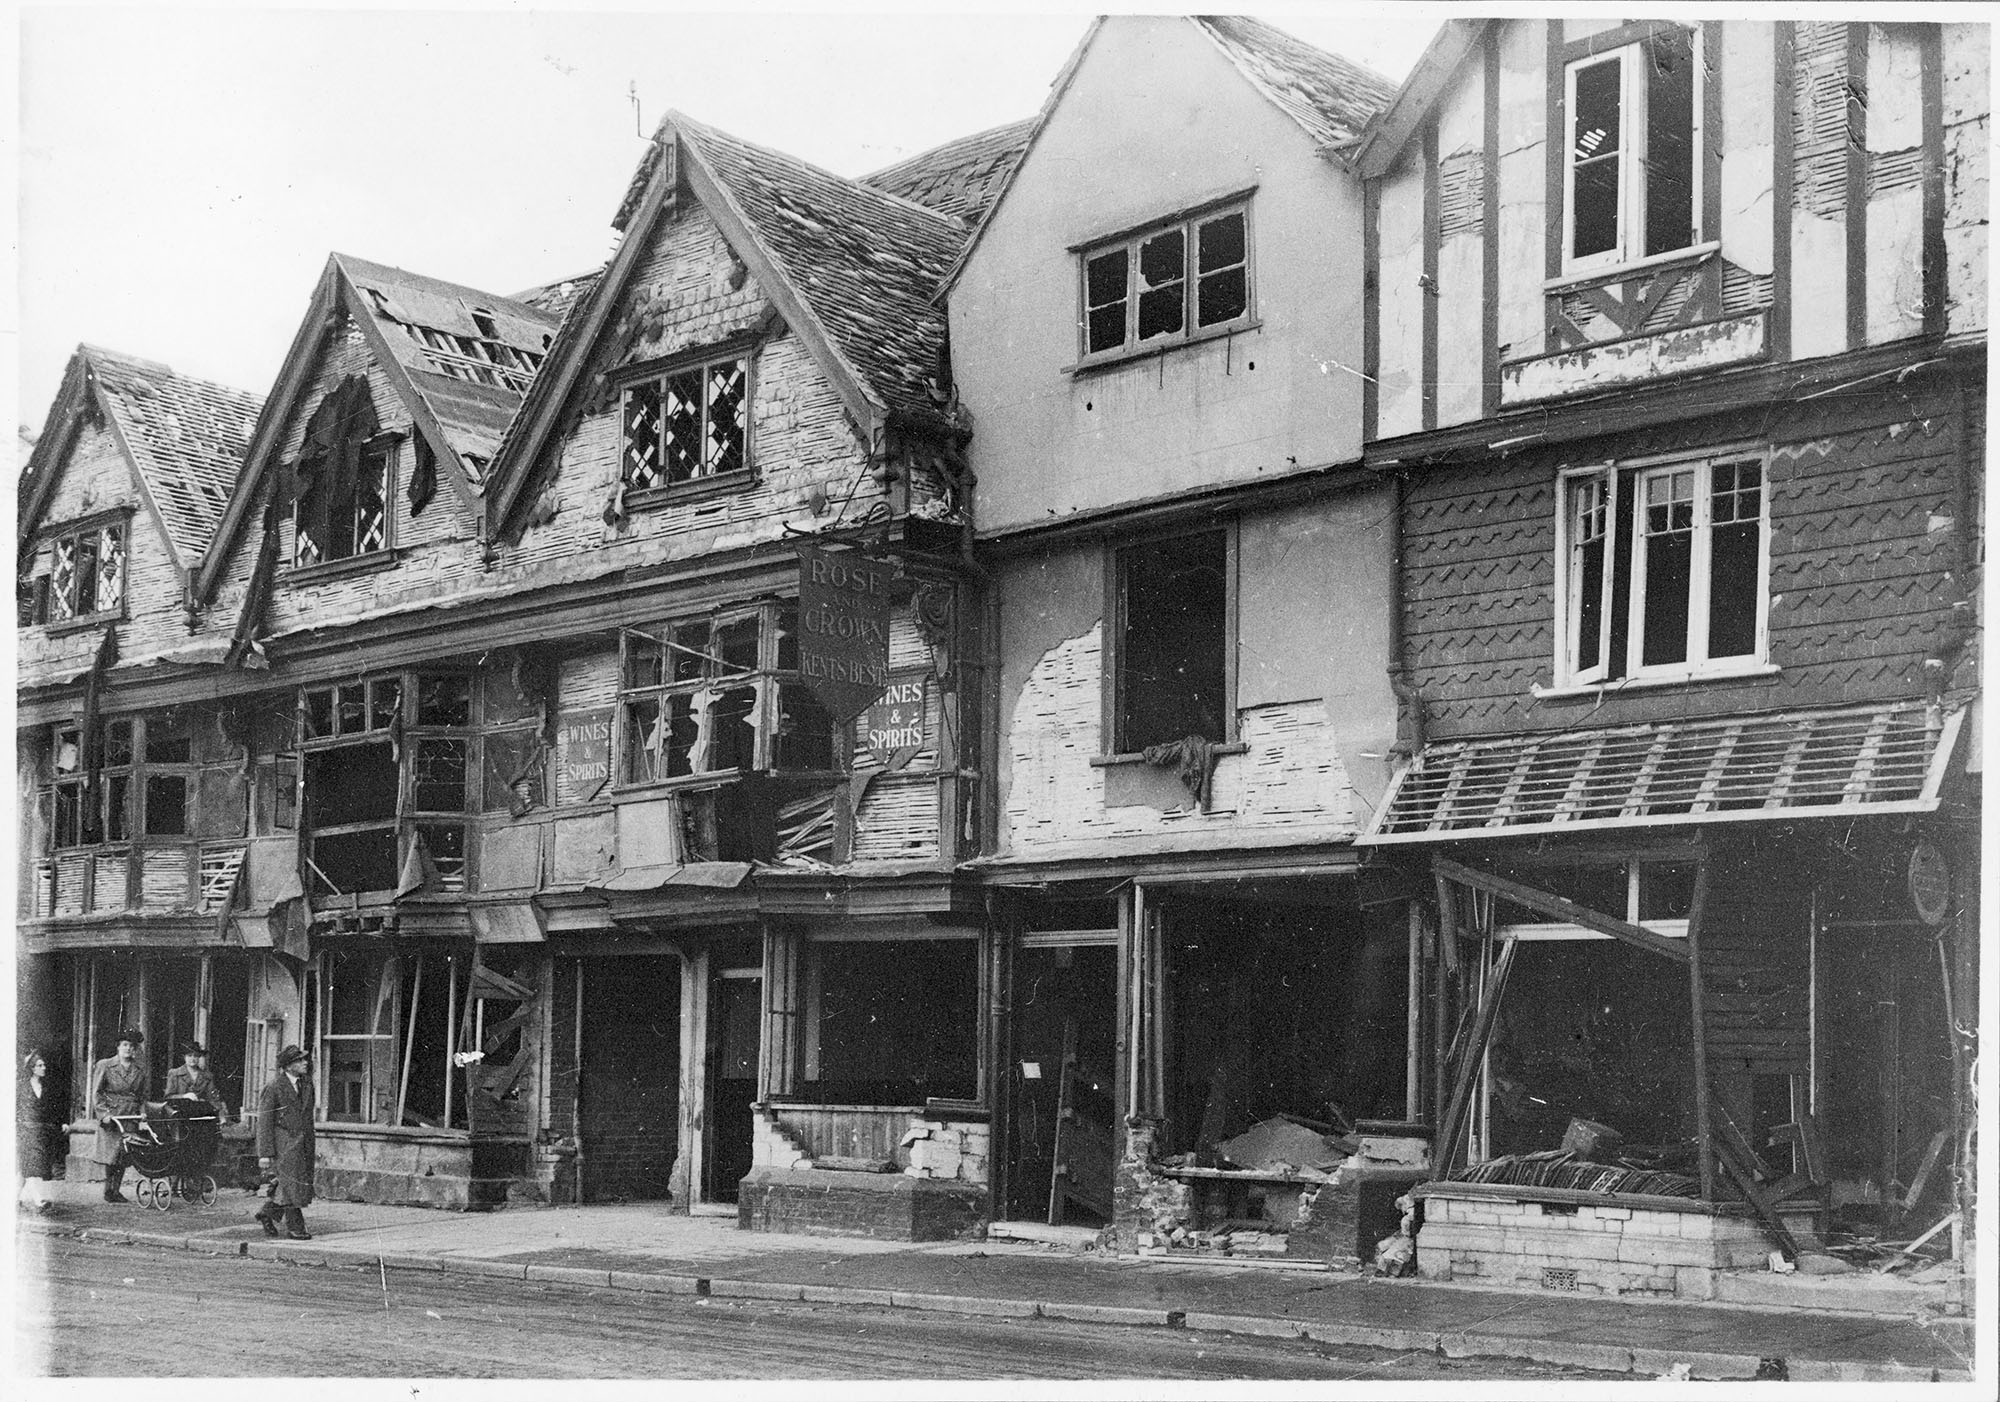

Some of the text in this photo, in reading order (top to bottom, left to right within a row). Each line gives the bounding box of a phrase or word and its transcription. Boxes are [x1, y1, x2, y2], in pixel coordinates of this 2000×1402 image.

[812, 559, 881, 594] ROSE
[834, 595, 860, 609] AND
[806, 609, 884, 642] CROWN
[890, 709, 901, 724] &
[570, 722, 609, 742] WINES
[869, 728, 922, 750] SPIRITS
[584, 746, 592, 759] &
[569, 762, 607, 780] SPIRITS
